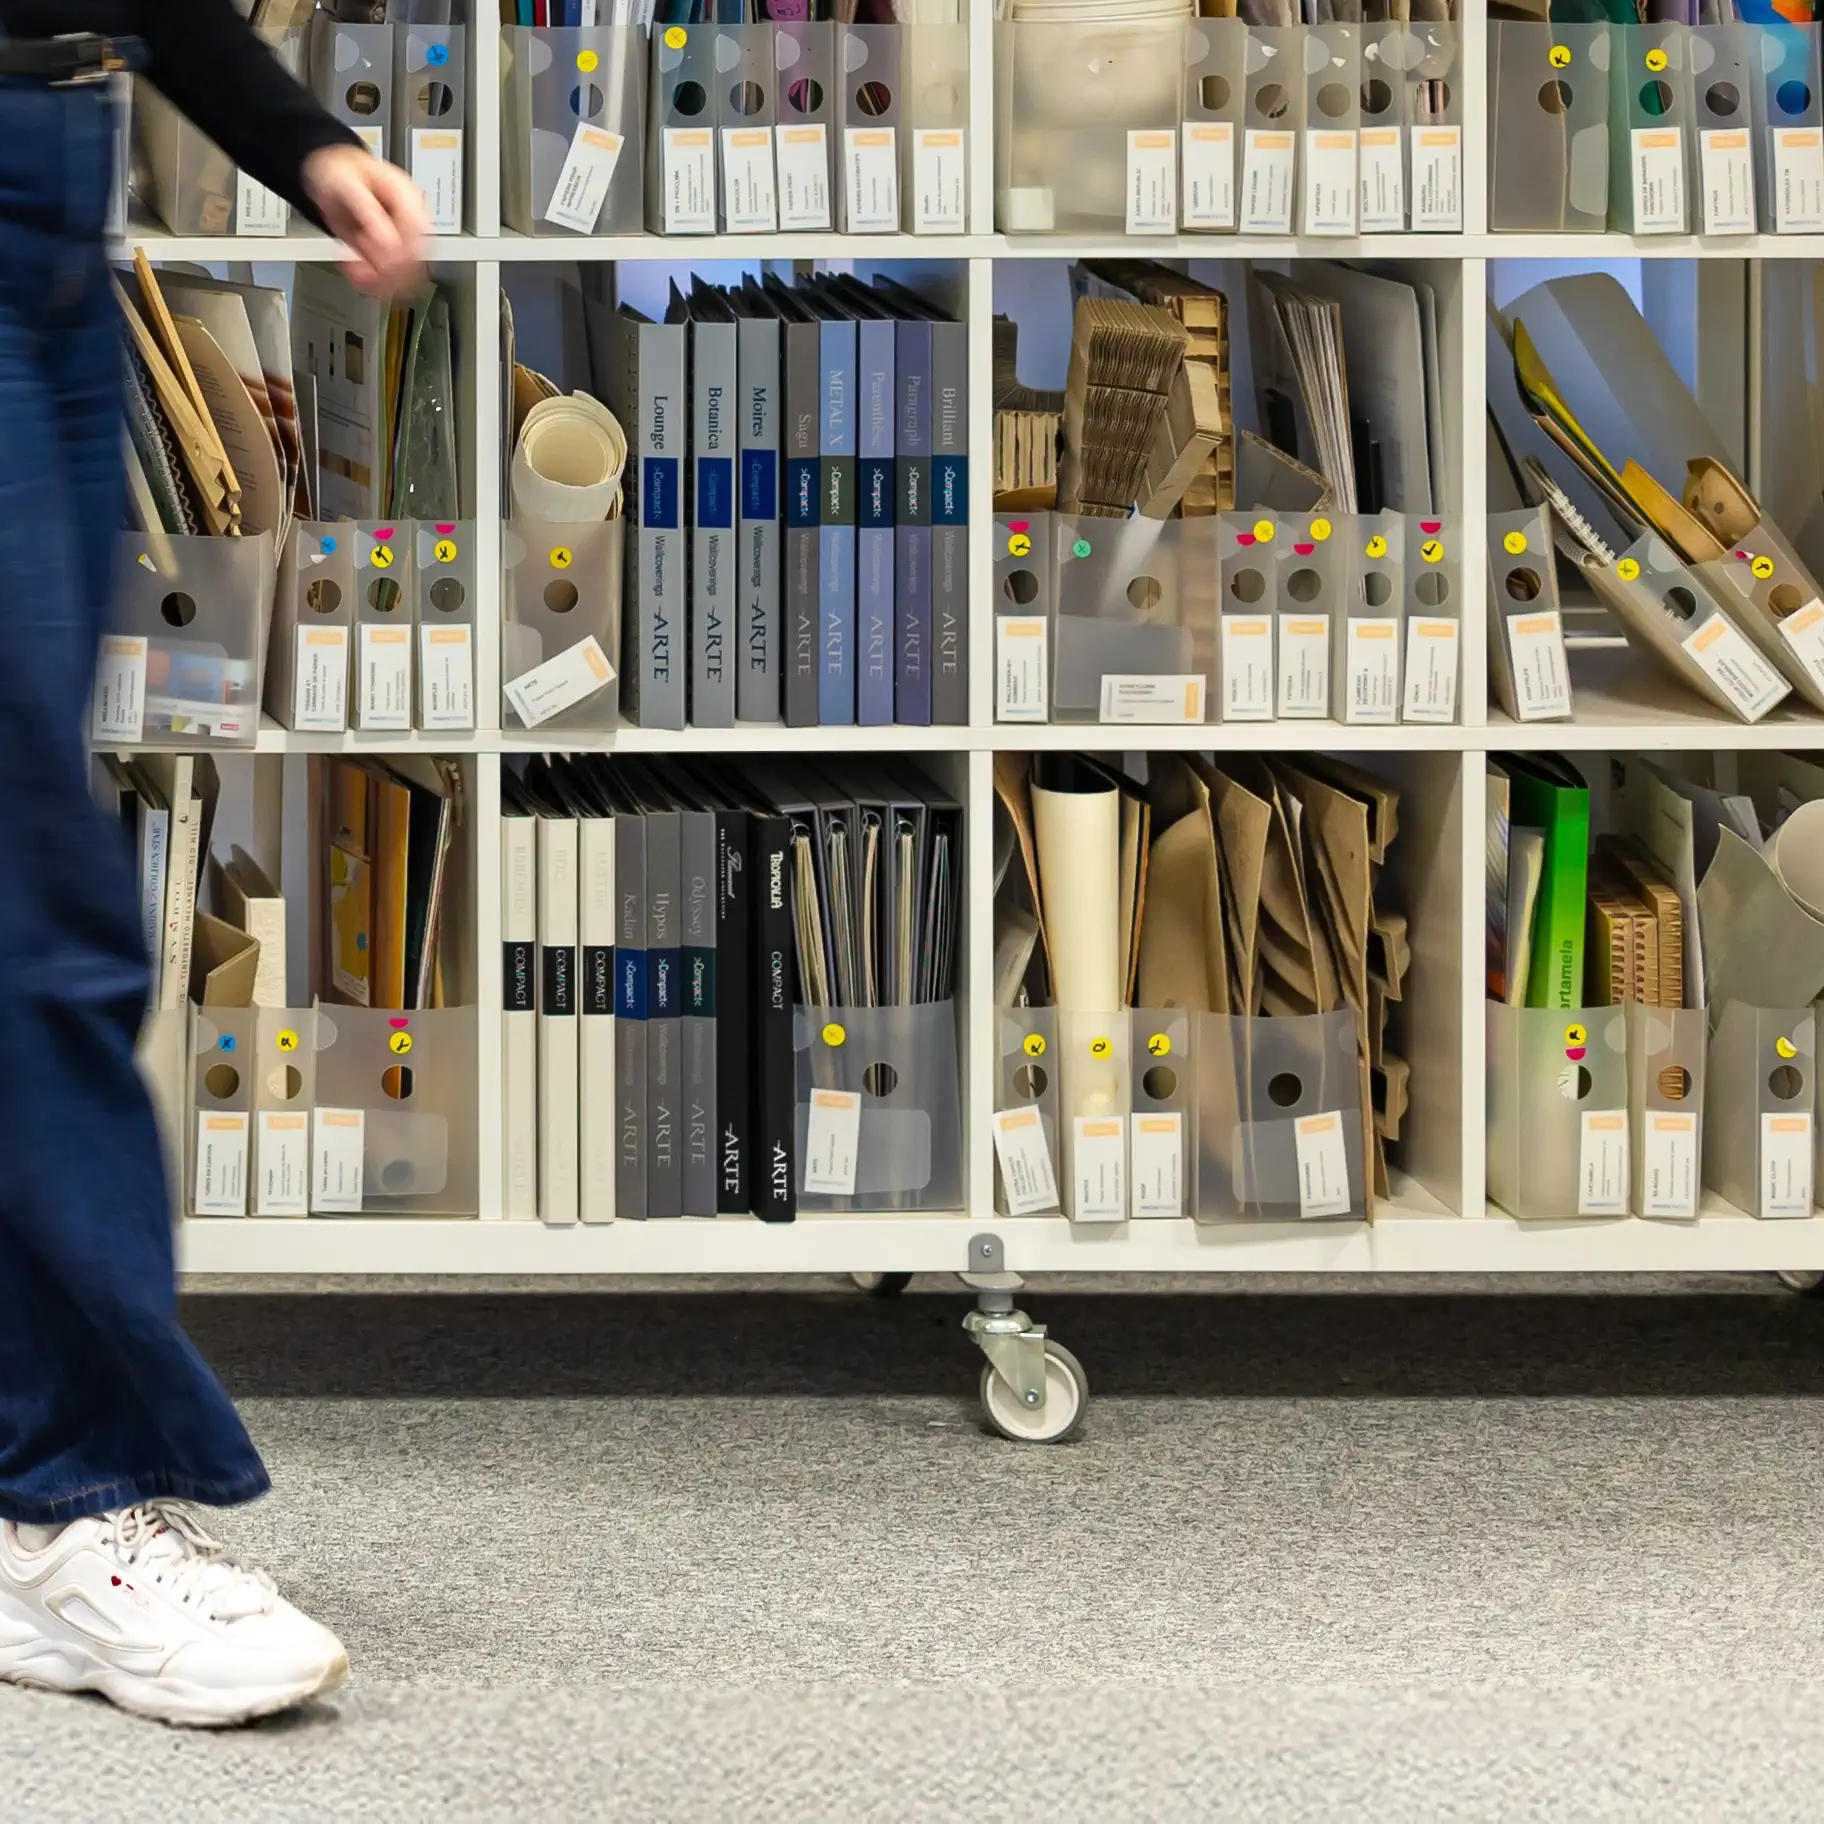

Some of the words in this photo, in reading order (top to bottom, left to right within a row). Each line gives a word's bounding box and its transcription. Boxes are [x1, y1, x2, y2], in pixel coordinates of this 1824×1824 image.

[653, 396, 667, 450] Lounge
[708, 387, 722, 450] Botanica
[752, 387, 766, 437] Moires
[829, 371, 843, 429] METAL
[907, 376, 920, 446] Paragraph
[941, 387, 956, 446] Brilliant
[797, 414, 810, 448] Saga
[829, 433, 843, 446] X
[654, 536, 664, 596] Wallcoverings
[708, 535, 718, 596] Wallcoverings
[752, 526, 763, 587] Wallcoverings
[149, 852, 159, 892] GOLDEN
[770, 851, 783, 909] TROPICALIA
[623, 894, 637, 939] Kadan
[654, 893, 670, 938] Hypos
[689, 876, 705, 937] Odyssey
[515, 948, 526, 1006] COMPACT
[555, 950, 566, 1008] COMPACT
[595, 951, 606, 1010] COMPACT
[772, 951, 783, 1010] COMPACT
[1559, 940, 1573, 1008] artamela
